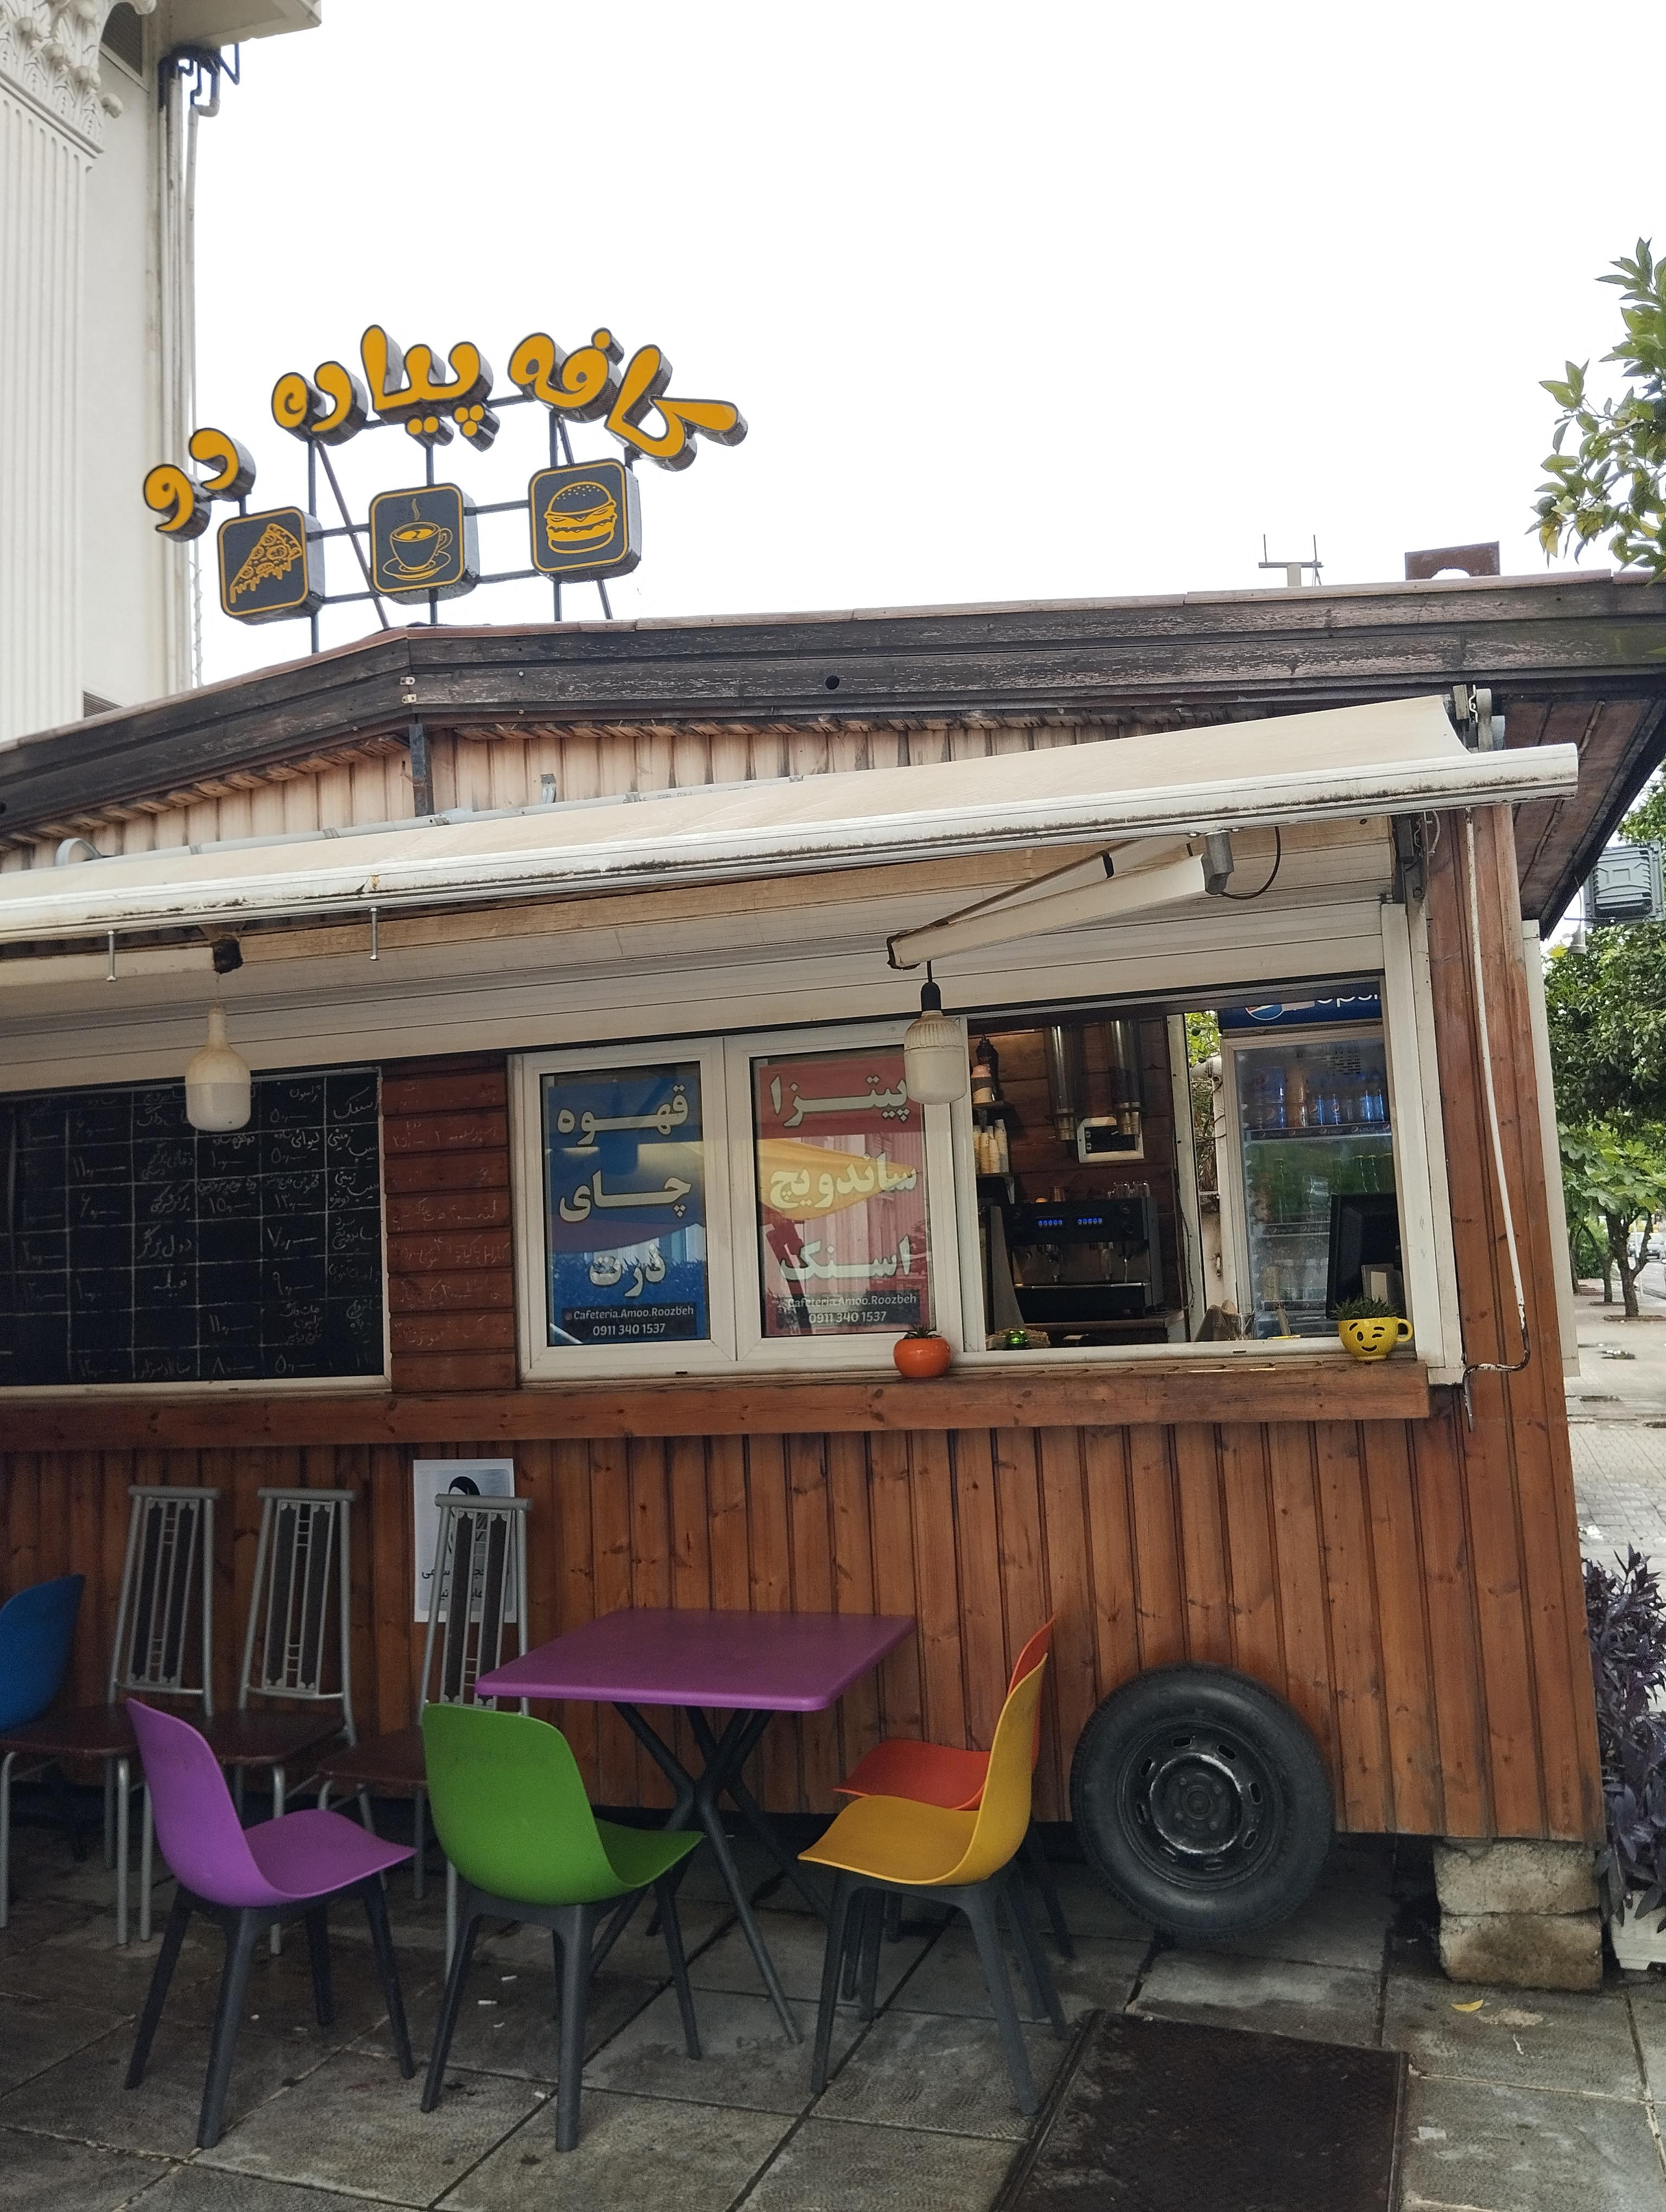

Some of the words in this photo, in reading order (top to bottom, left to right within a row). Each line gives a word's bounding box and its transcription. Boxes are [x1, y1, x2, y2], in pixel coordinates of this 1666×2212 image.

[271, 324, 491, 447] پیاده
[507, 328, 742, 461] کافه
[557, 1084, 689, 1146] قهوه
[769, 1075, 911, 1128] پیتزا
[559, 1169, 691, 1223] چای
[769, 1150, 917, 1210] ساندویچ
[589, 1243, 666, 1297] ذرت
[779, 1234, 911, 1281] اسنک
[573, 1305, 695, 1321] Cafeteria.Amoo.Roozbeh
[592, 1325, 616, 1337] 0911
[618, 1324, 640, 1336] 340
[642, 1323, 667, 1335] 1537
[809, 1313, 833, 1324] 0911
[836, 1312, 859, 1324] 340
[861, 1310, 887, 1322] 1537
